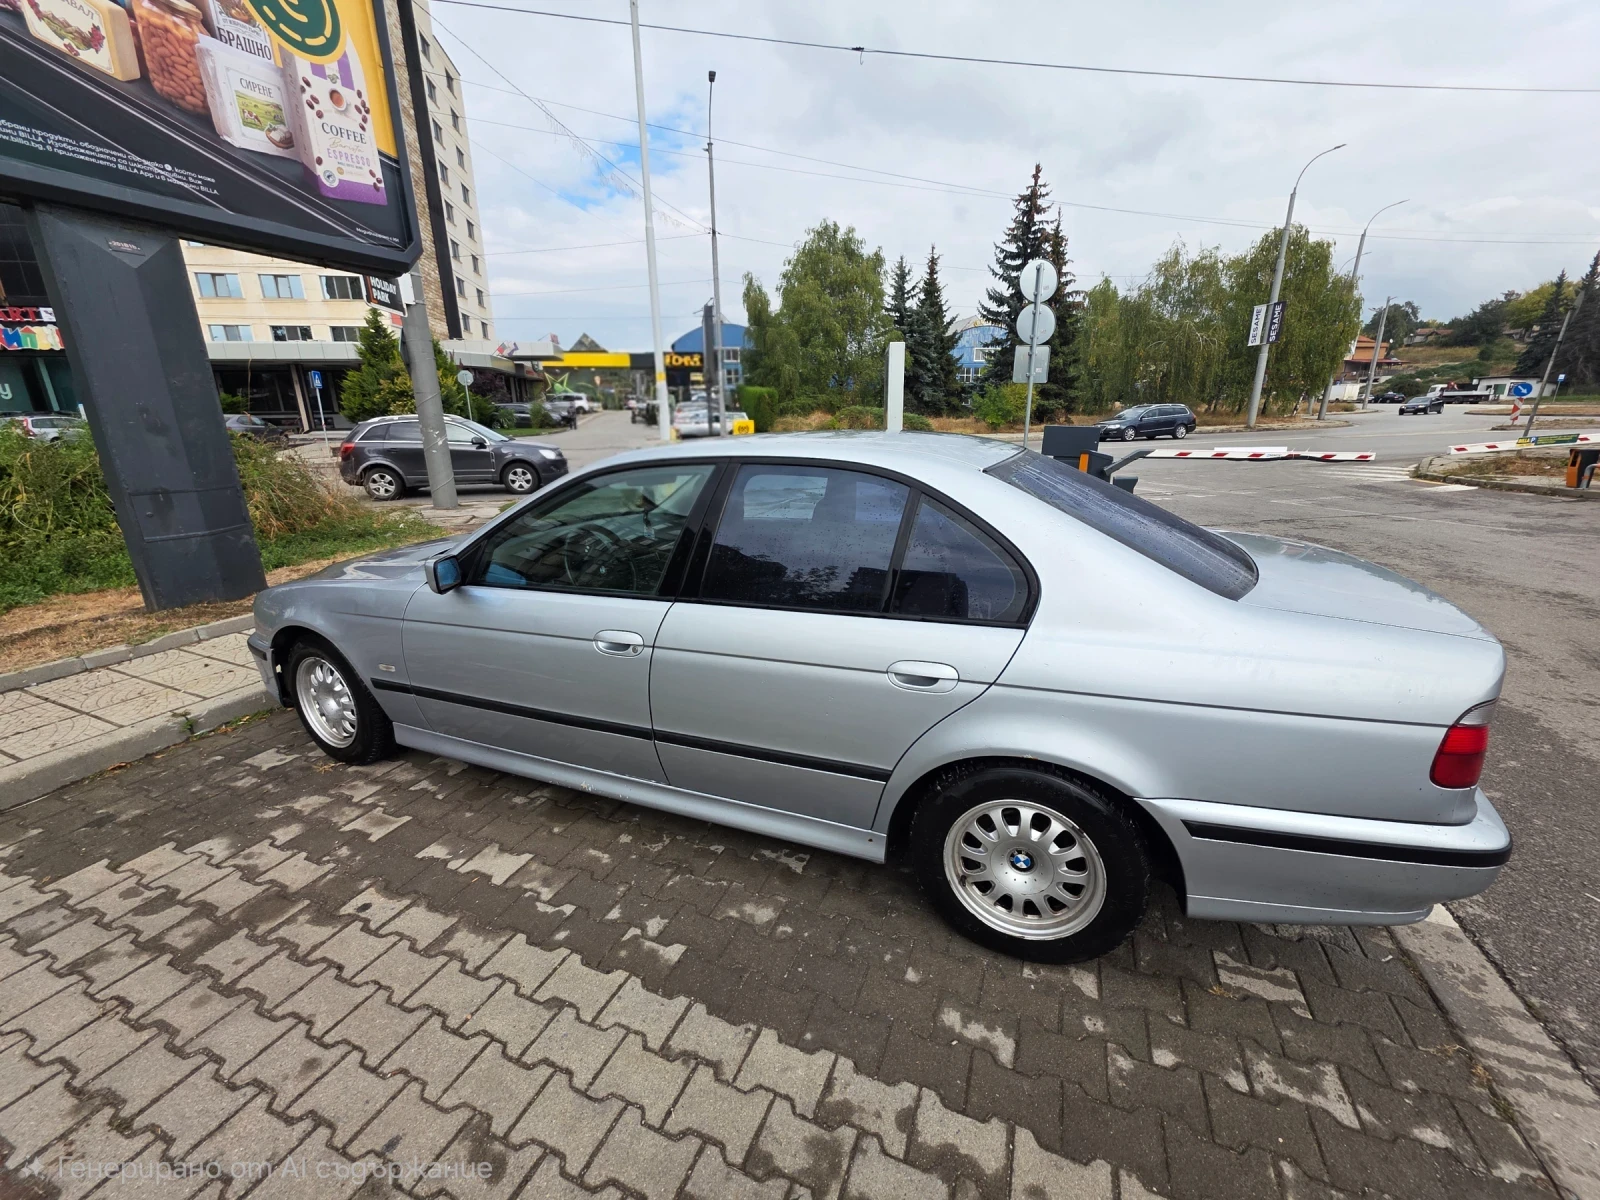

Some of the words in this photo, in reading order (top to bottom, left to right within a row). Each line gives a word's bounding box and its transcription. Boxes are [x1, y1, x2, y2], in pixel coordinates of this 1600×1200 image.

[62, 0, 94, 20] ВАЛ
[216, 26, 272, 60] БРАШНО
[240, 78, 274, 98] СИРЕНЕ
[322, 122, 366, 144] COFFEE
[326, 148, 370, 166] ESPRESSO
[118, 164, 138, 174] BILLA
[140, 170, 154, 178] App
[370, 276, 396, 294] HOLIDAY
[372, 288, 390, 304] PARK
[1251, 308, 1262, 344] SESAME
[1270, 304, 1282, 342] SESAME
